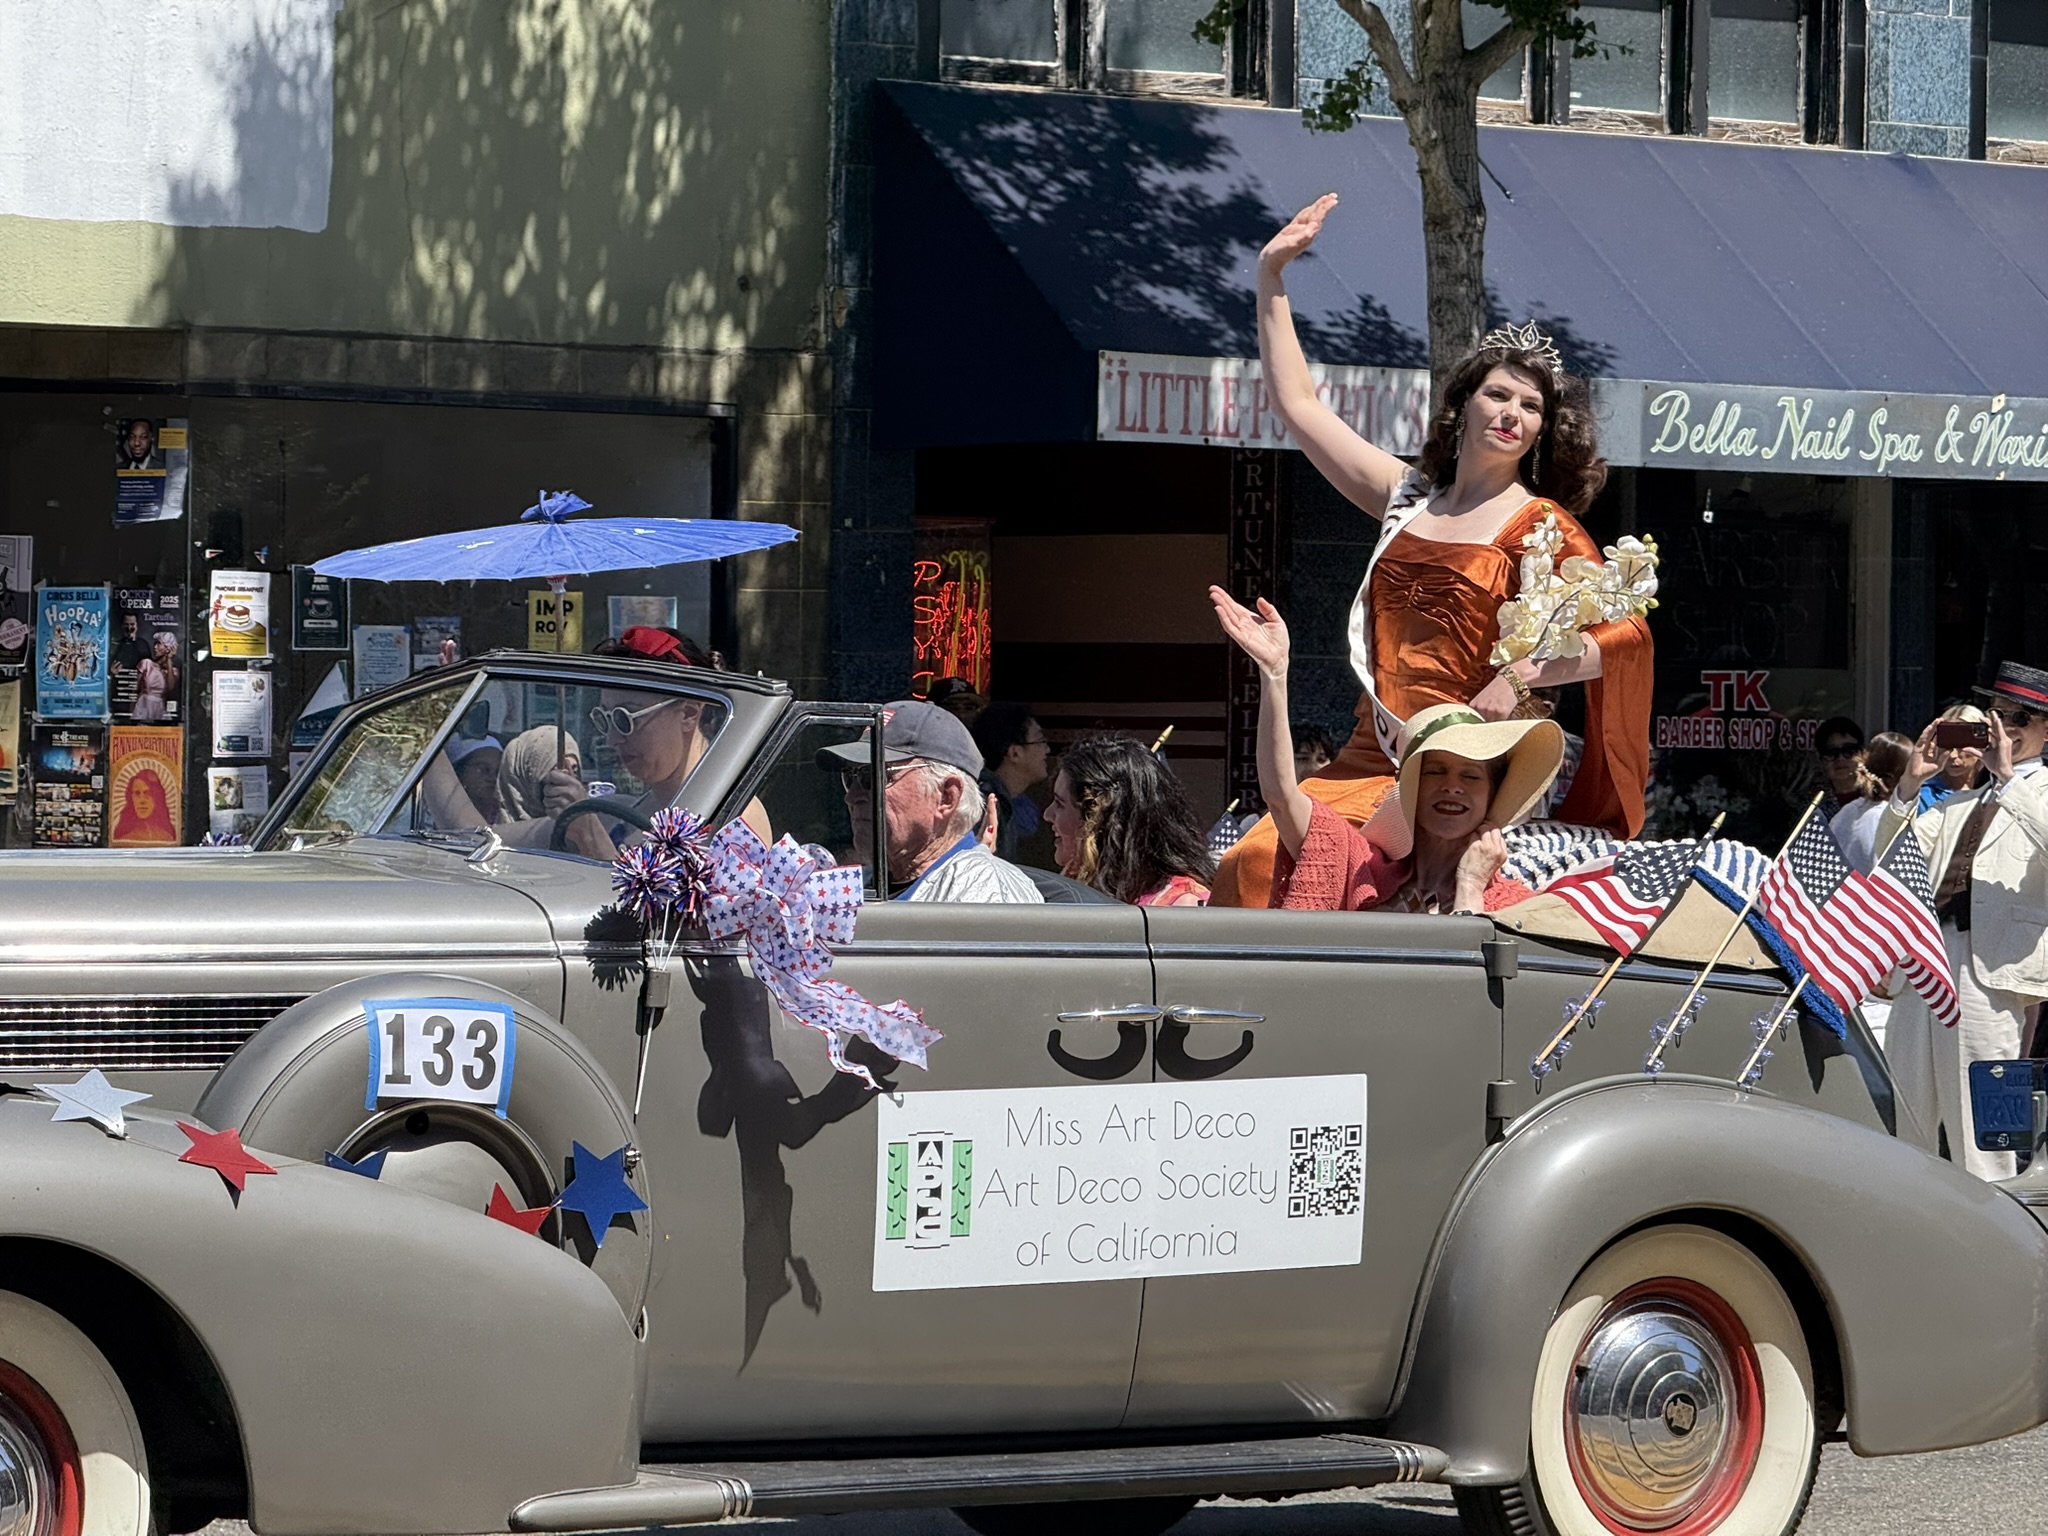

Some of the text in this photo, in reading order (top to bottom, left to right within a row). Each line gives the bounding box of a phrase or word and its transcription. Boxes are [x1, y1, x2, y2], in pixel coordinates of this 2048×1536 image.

[1115, 370, 1241, 438] LITTLE
[1649, 389, 2048, 472] Bella Nail Spa & Waxi
[44, 604, 102, 628] HOOPLA!
[76, 591, 100, 601] BELLA
[114, 589, 155, 600] POCKET
[120, 599, 153, 609] OPERA
[1701, 670, 1770, 712] TK
[1656, 716, 1824, 750] BARBER SHOP & SP
[384, 1013, 498, 1091] 133
[1006, 1100, 1257, 1148] Miss Art Deco
[977, 1160, 1279, 1210] Art Deco Society
[1016, 1221, 1239, 1267] of California
